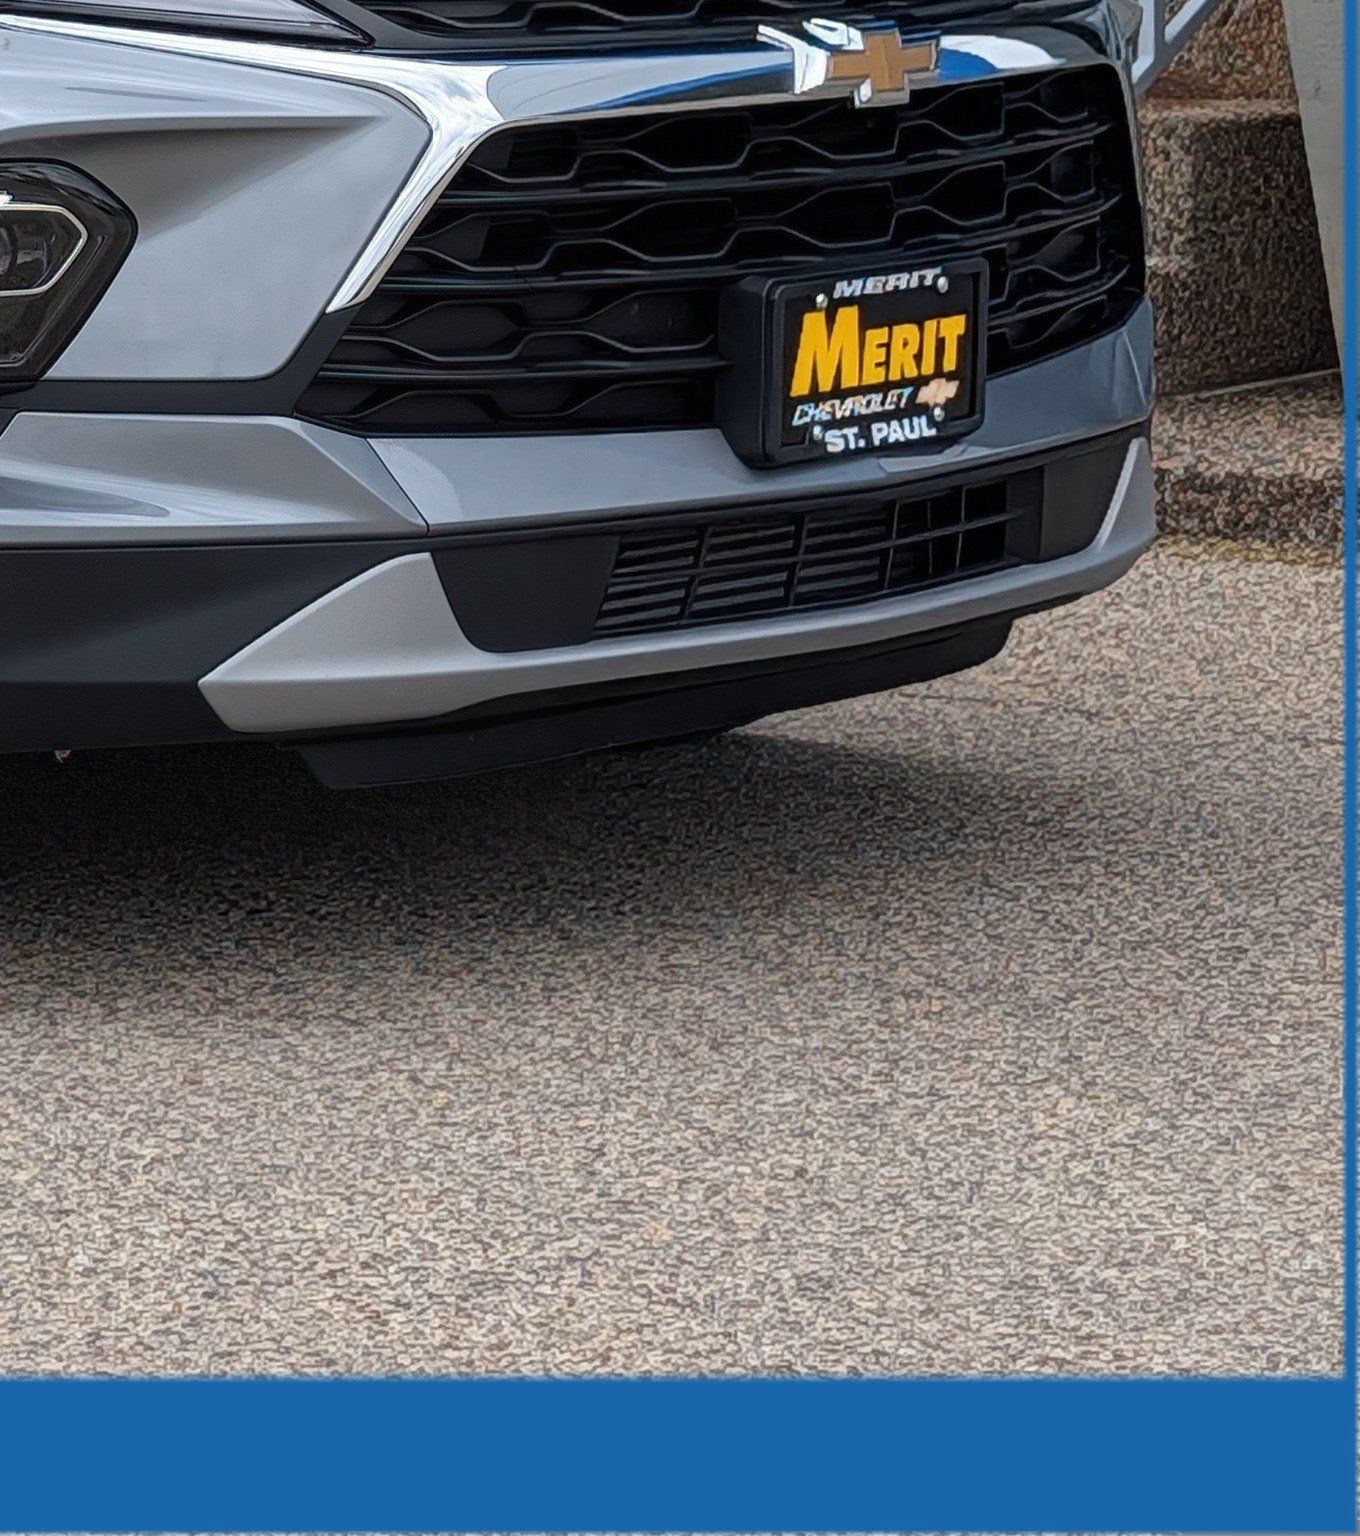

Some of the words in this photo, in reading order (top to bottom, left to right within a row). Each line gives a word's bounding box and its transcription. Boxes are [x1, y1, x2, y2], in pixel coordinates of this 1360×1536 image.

[833, 266, 943, 299] MERIT
[789, 305, 967, 397] MERIT
[791, 386, 915, 426] CHEVROLET
[824, 426, 866, 453] ST.
[872, 414, 937, 447] PAUL
